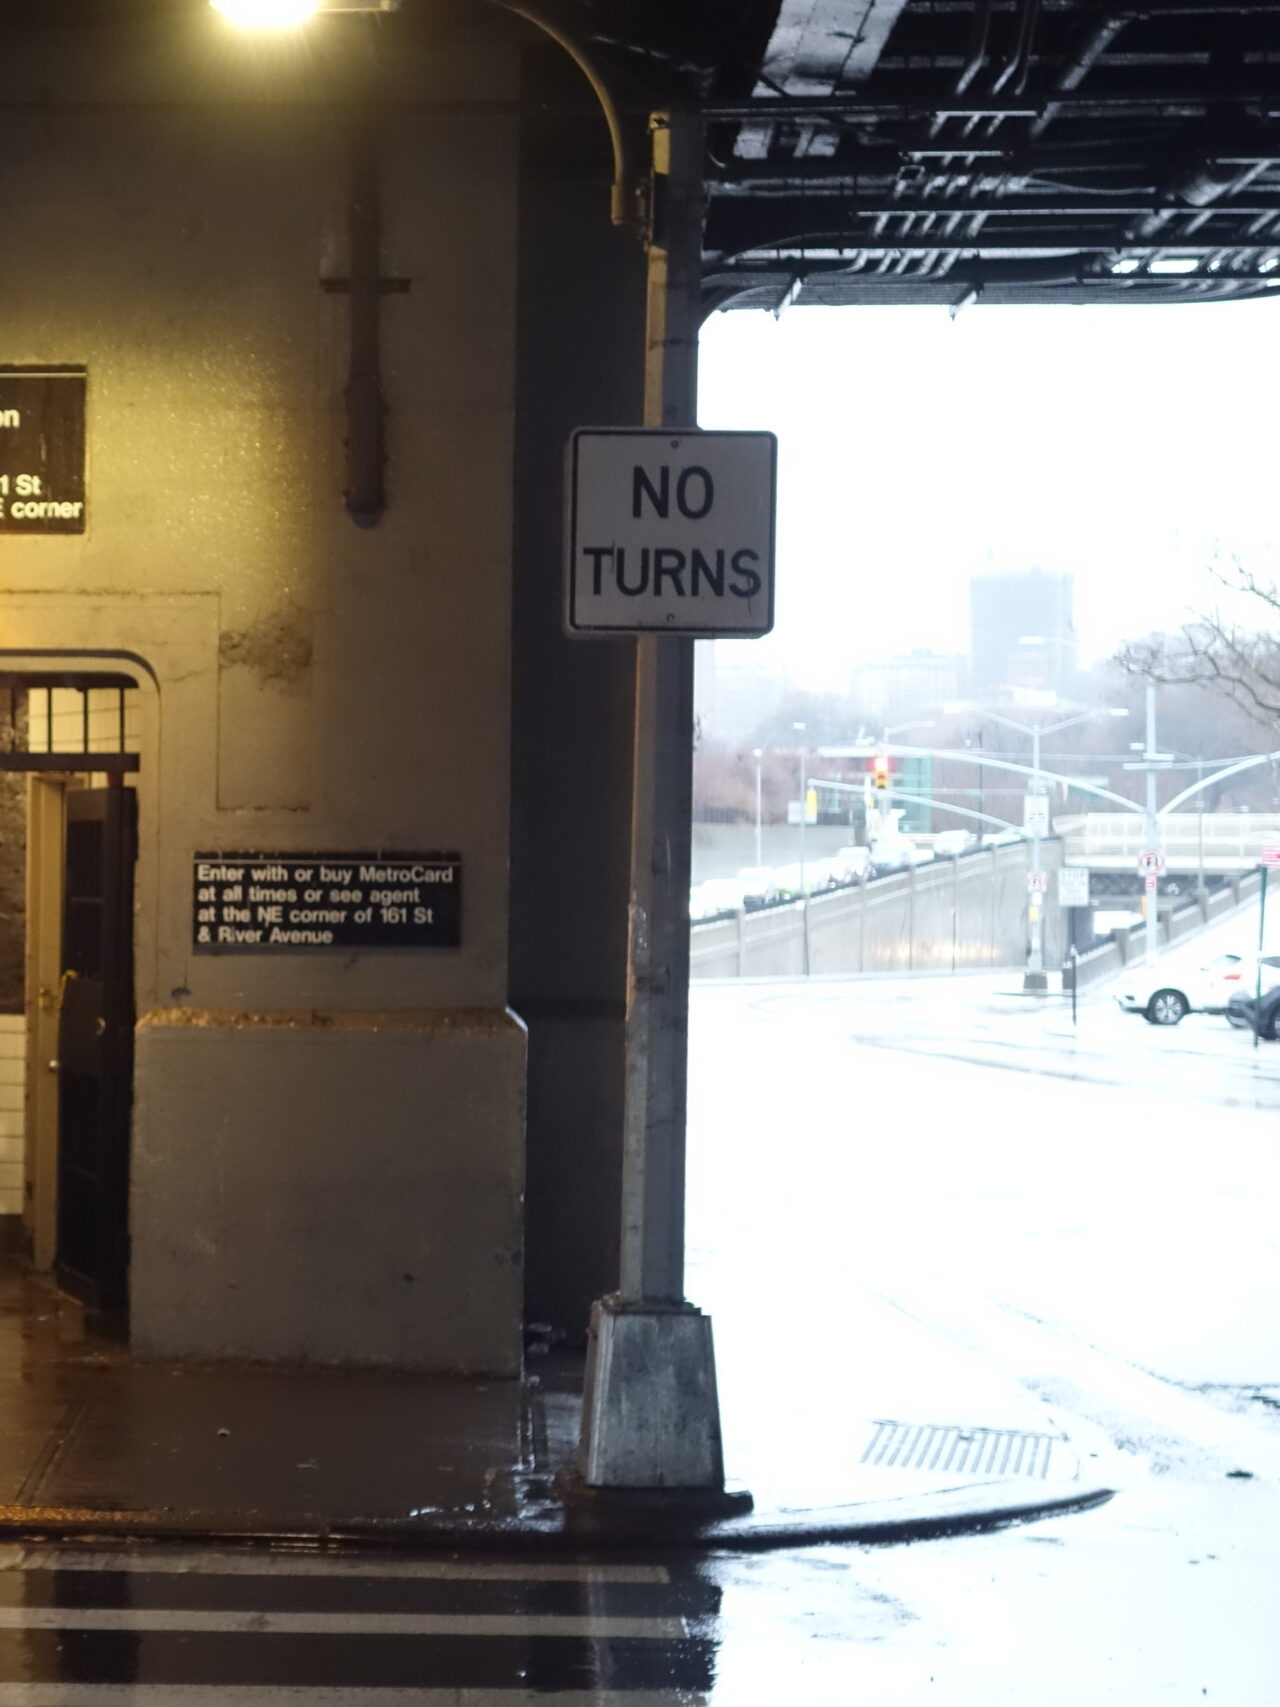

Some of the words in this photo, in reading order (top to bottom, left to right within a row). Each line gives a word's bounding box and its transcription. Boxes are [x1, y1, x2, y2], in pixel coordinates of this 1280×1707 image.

[15, 474, 42, 495] St
[632, 465, 714, 520] NO
[10, 501, 83, 518] corner
[583, 547, 762, 598] TURNS
[198, 865, 245, 882] Enter
[251, 865, 288, 882] with
[294, 868, 313, 882] or
[320, 866, 353, 886] buy
[359, 867, 453, 883] MetroCard
[198, 887, 216, 902] at
[222, 886, 243, 902] all
[249, 886, 298, 902] times
[304, 889, 323, 902] or
[329, 889, 363, 903] see
[370, 888, 421, 906] agent
[198, 907, 216, 922] at
[222, 906, 252, 922] the
[257, 907, 283, 923] NE
[289, 909, 348, 923] corner
[354, 907, 373, 923] of
[379, 907, 408, 923] 161
[414, 907, 433, 924] St
[197, 926, 211, 943] &
[218, 926, 263, 943] River
[269, 927, 334, 944] Avenue
